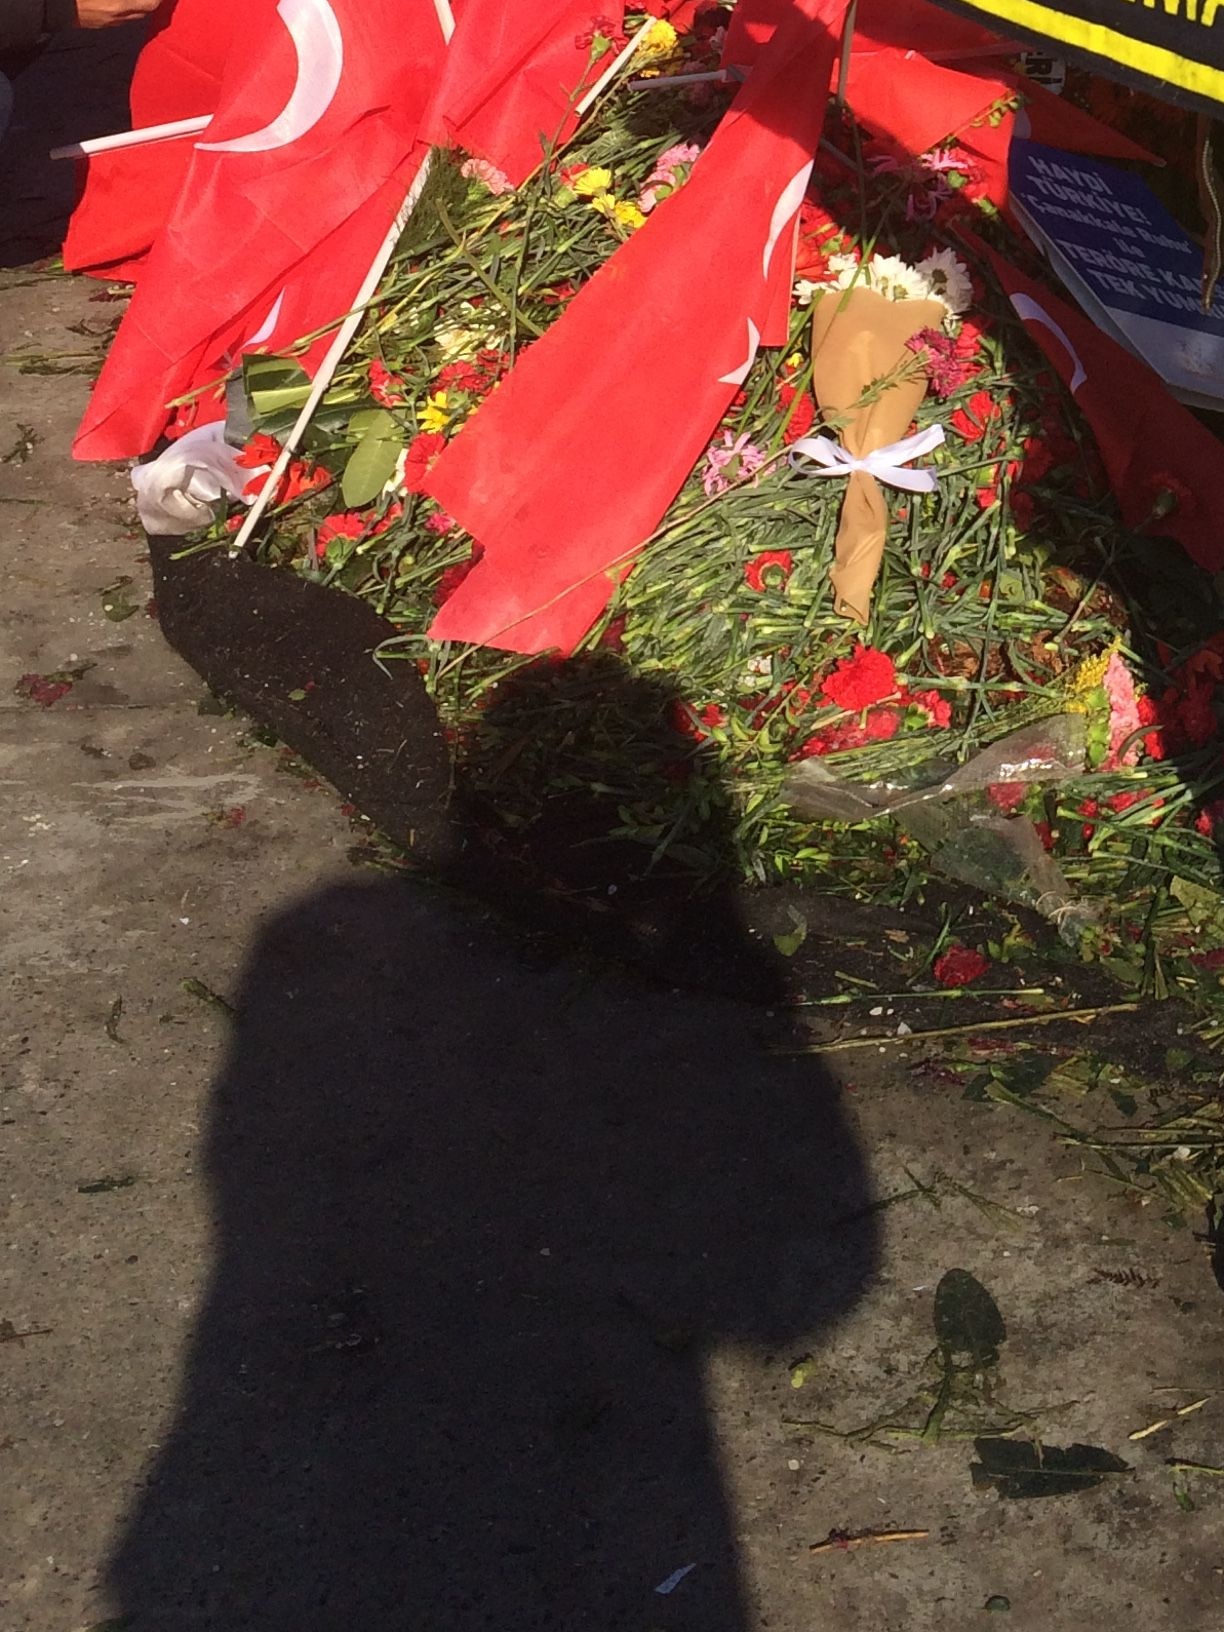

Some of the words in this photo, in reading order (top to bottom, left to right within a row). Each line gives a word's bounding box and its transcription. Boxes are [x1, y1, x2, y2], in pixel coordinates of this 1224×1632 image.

[1028, 155, 1114, 196] HAYDİ
[1055, 237, 1162, 283] TERÖRE
[1086, 268, 1147, 299] TEK
